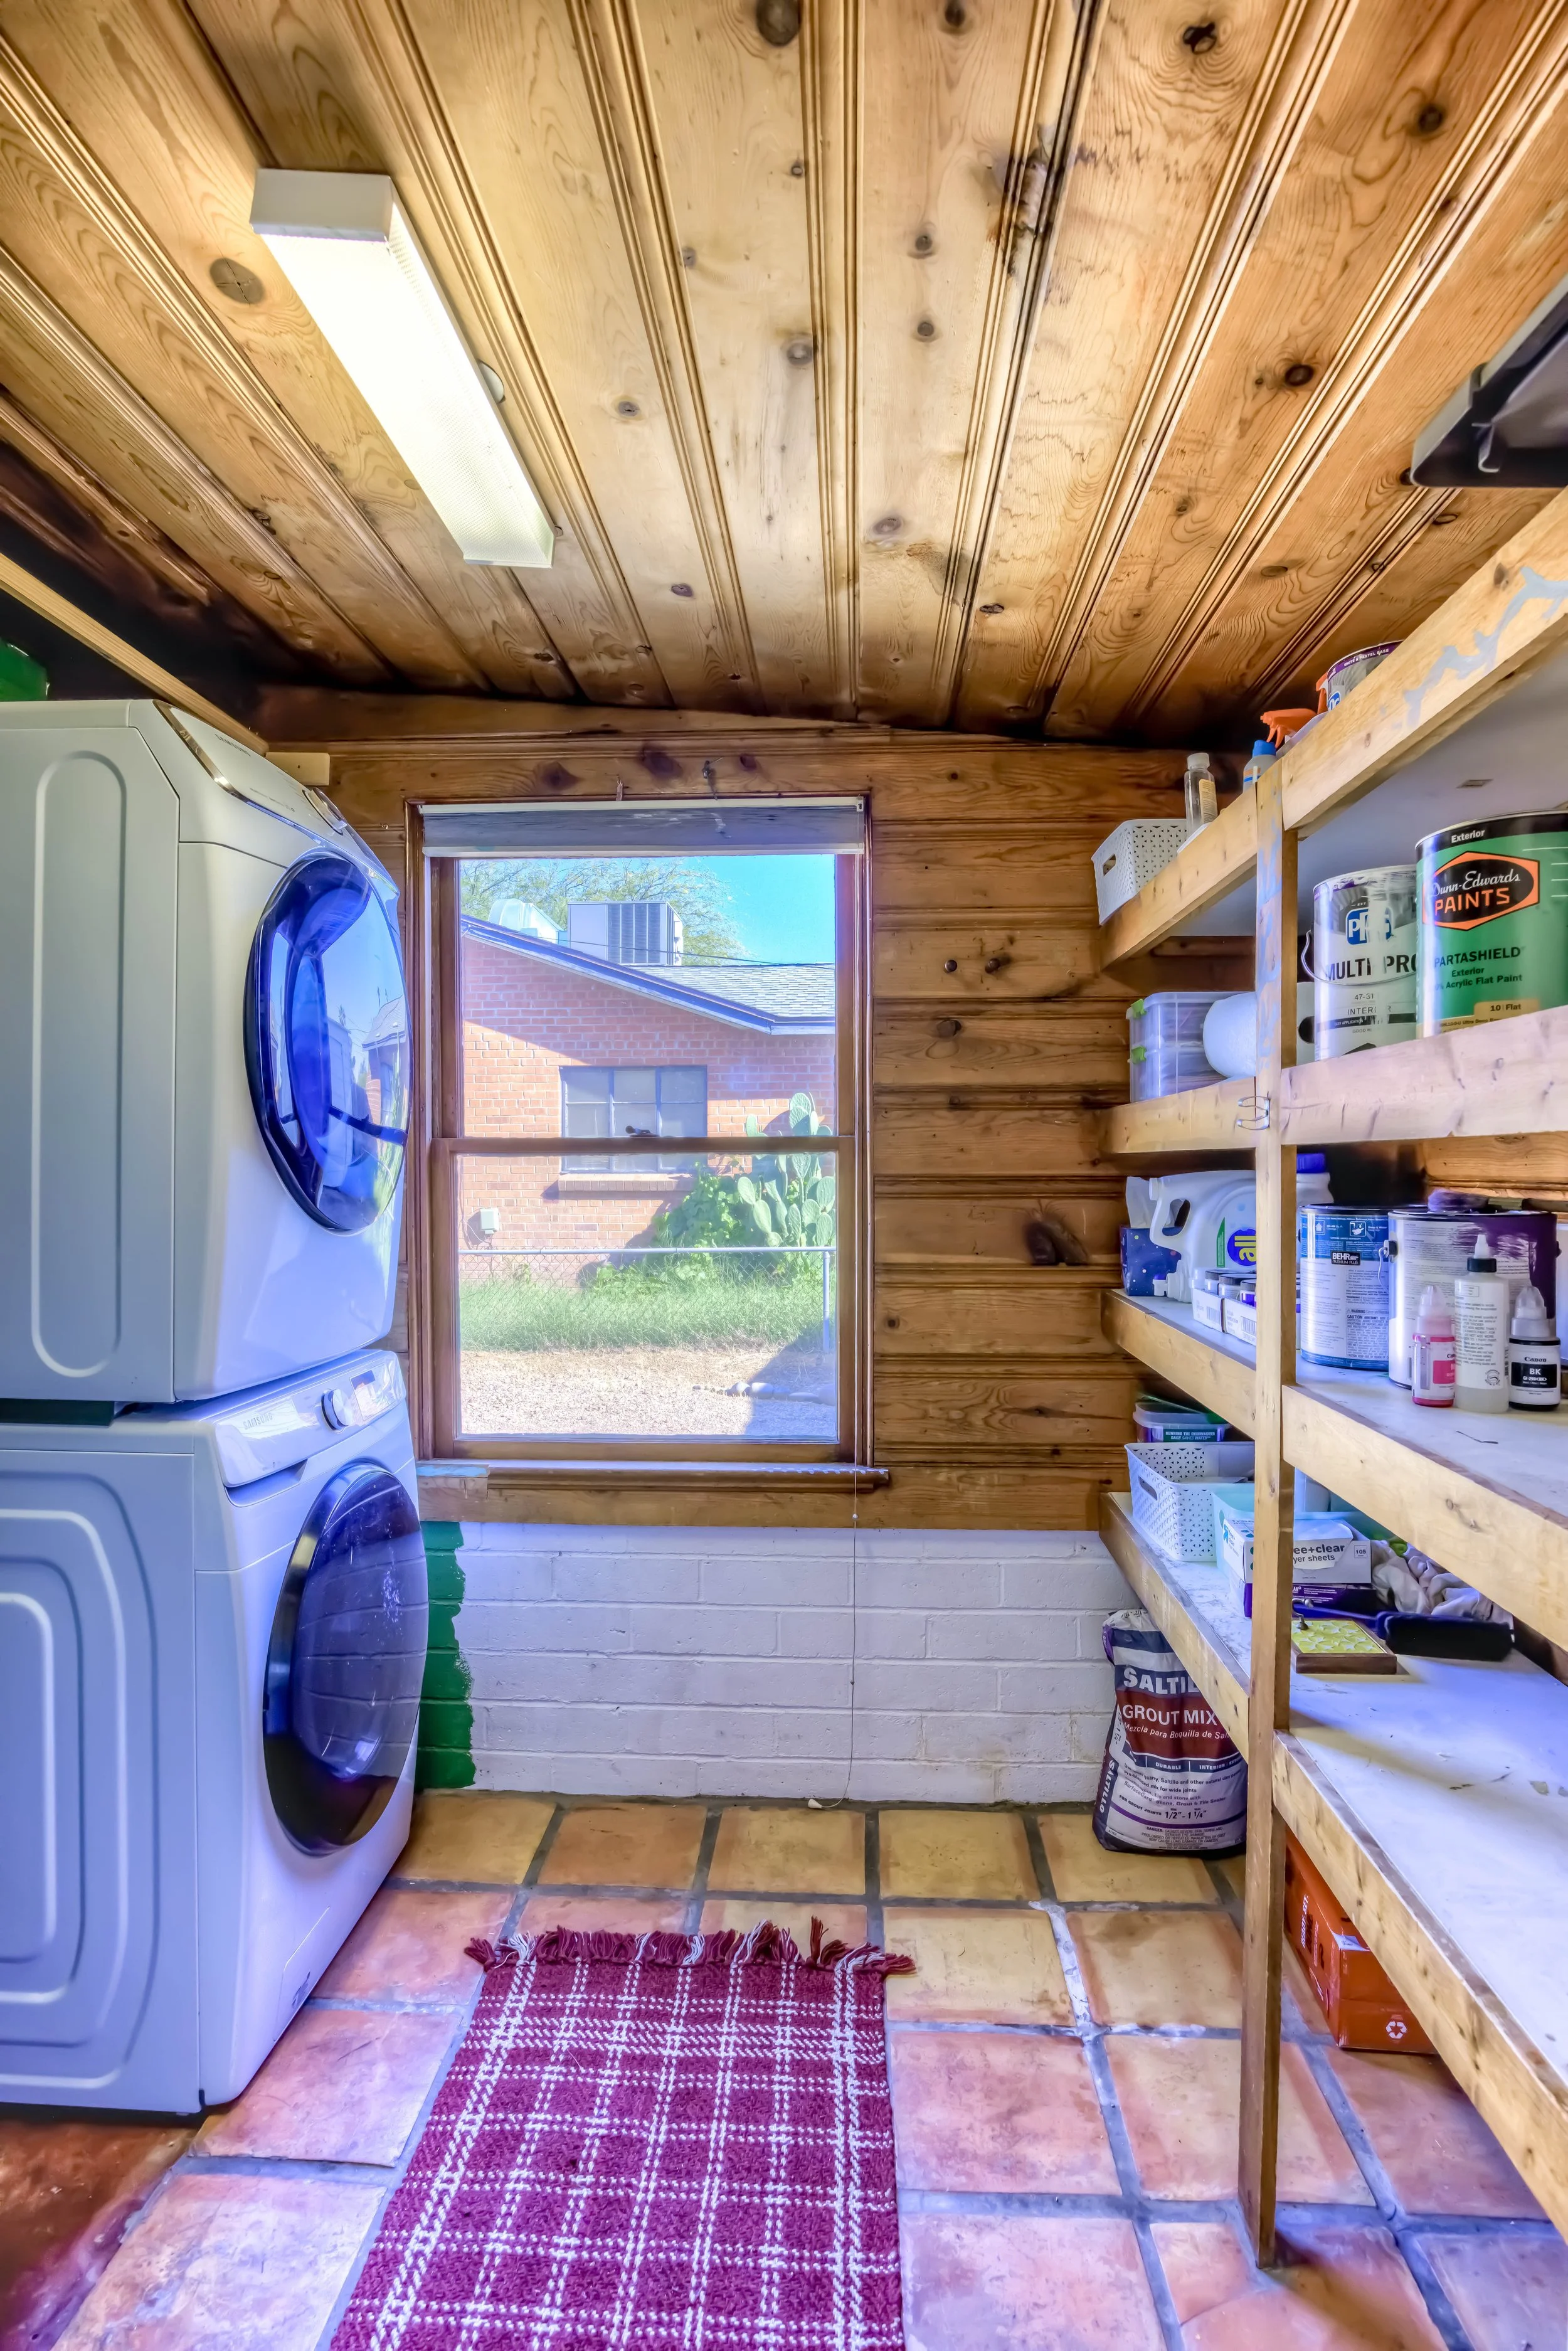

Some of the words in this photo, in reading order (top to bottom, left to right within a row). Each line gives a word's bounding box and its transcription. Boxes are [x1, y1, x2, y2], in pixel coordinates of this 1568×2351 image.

[1359, 652, 1375, 661] PASTEL
[1451, 829, 1485, 843] Exterior
[1432, 868, 1521, 897] Dunn-Edwards
[1434, 888, 1510, 916] PAINTS
[1434, 946, 1521, 968] PARTASHIELD
[1325, 957, 1372, 982] MULTI
[1451, 967, 1485, 978] Exterior
[1446, 979, 1473, 989] Acrylic
[1476, 975, 1493, 985] Flat
[1496, 974, 1523, 983] Paint
[1234, 1235, 1256, 1262] all
[1332, 1252, 1350, 1260] BEHR
[243, 1413, 273, 1430] SAMSUNG
[1293, 1544, 1345, 1555] ee+clear
[1293, 1555, 1305, 1564] yer
[1123, 1667, 1200, 1694] SALTIL
[1122, 1704, 1180, 1725] GROUT
[1184, 1710, 1217, 1726] MIX
[1125, 1722, 1148, 1733] Mezcla
[1150, 1729, 1167, 1739] para
[1170, 1730, 1200, 1739] Boquilla
[1099, 1759, 1116, 1813] SALTILLO
[1124, 1770, 1150, 1787] Pre-blended
[1143, 1774, 1159, 1782] quarry,
[1119, 1794, 1128, 1802] FOR
[1128, 1800, 1143, 1810] GROUT
